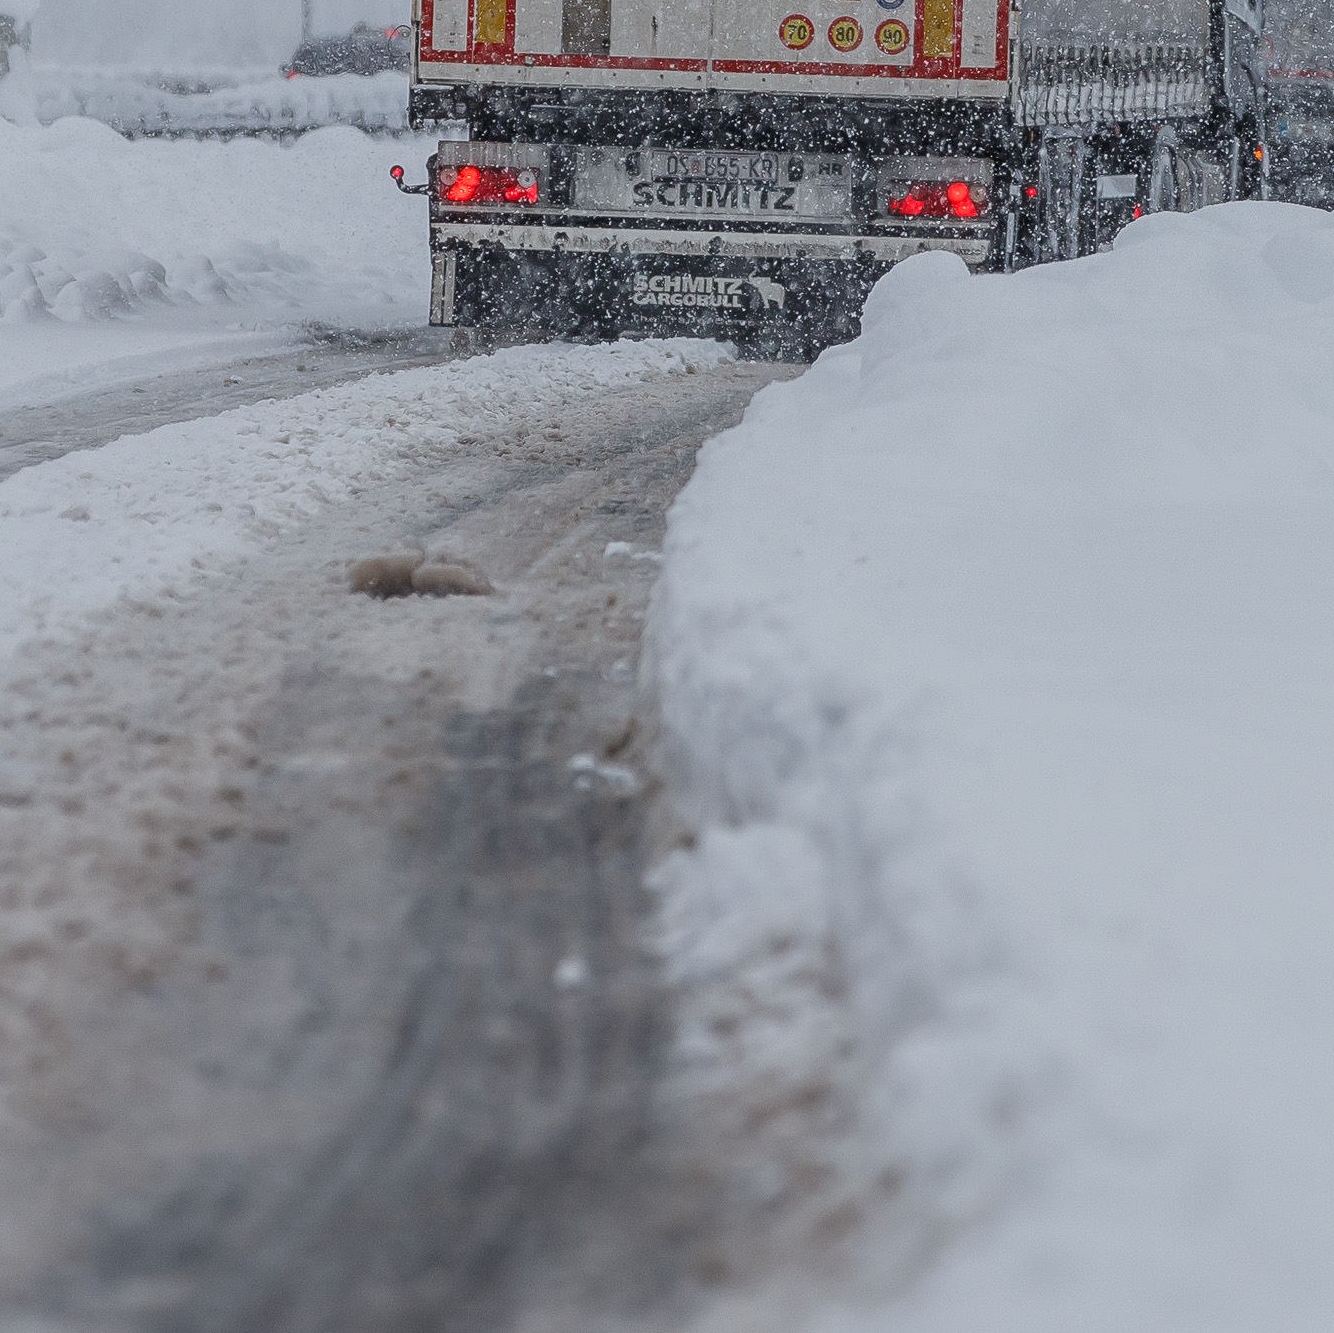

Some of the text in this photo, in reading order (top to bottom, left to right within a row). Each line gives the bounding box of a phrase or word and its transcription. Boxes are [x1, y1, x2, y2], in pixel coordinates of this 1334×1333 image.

[787, 24, 808, 40] 70
[835, 26, 856, 43] 80
[882, 28, 903, 45] 90
[632, 181, 796, 210] SCHMITZ
[633, 274, 743, 295] SCHMITZ
[632, 292, 742, 308] CARGOBULL
